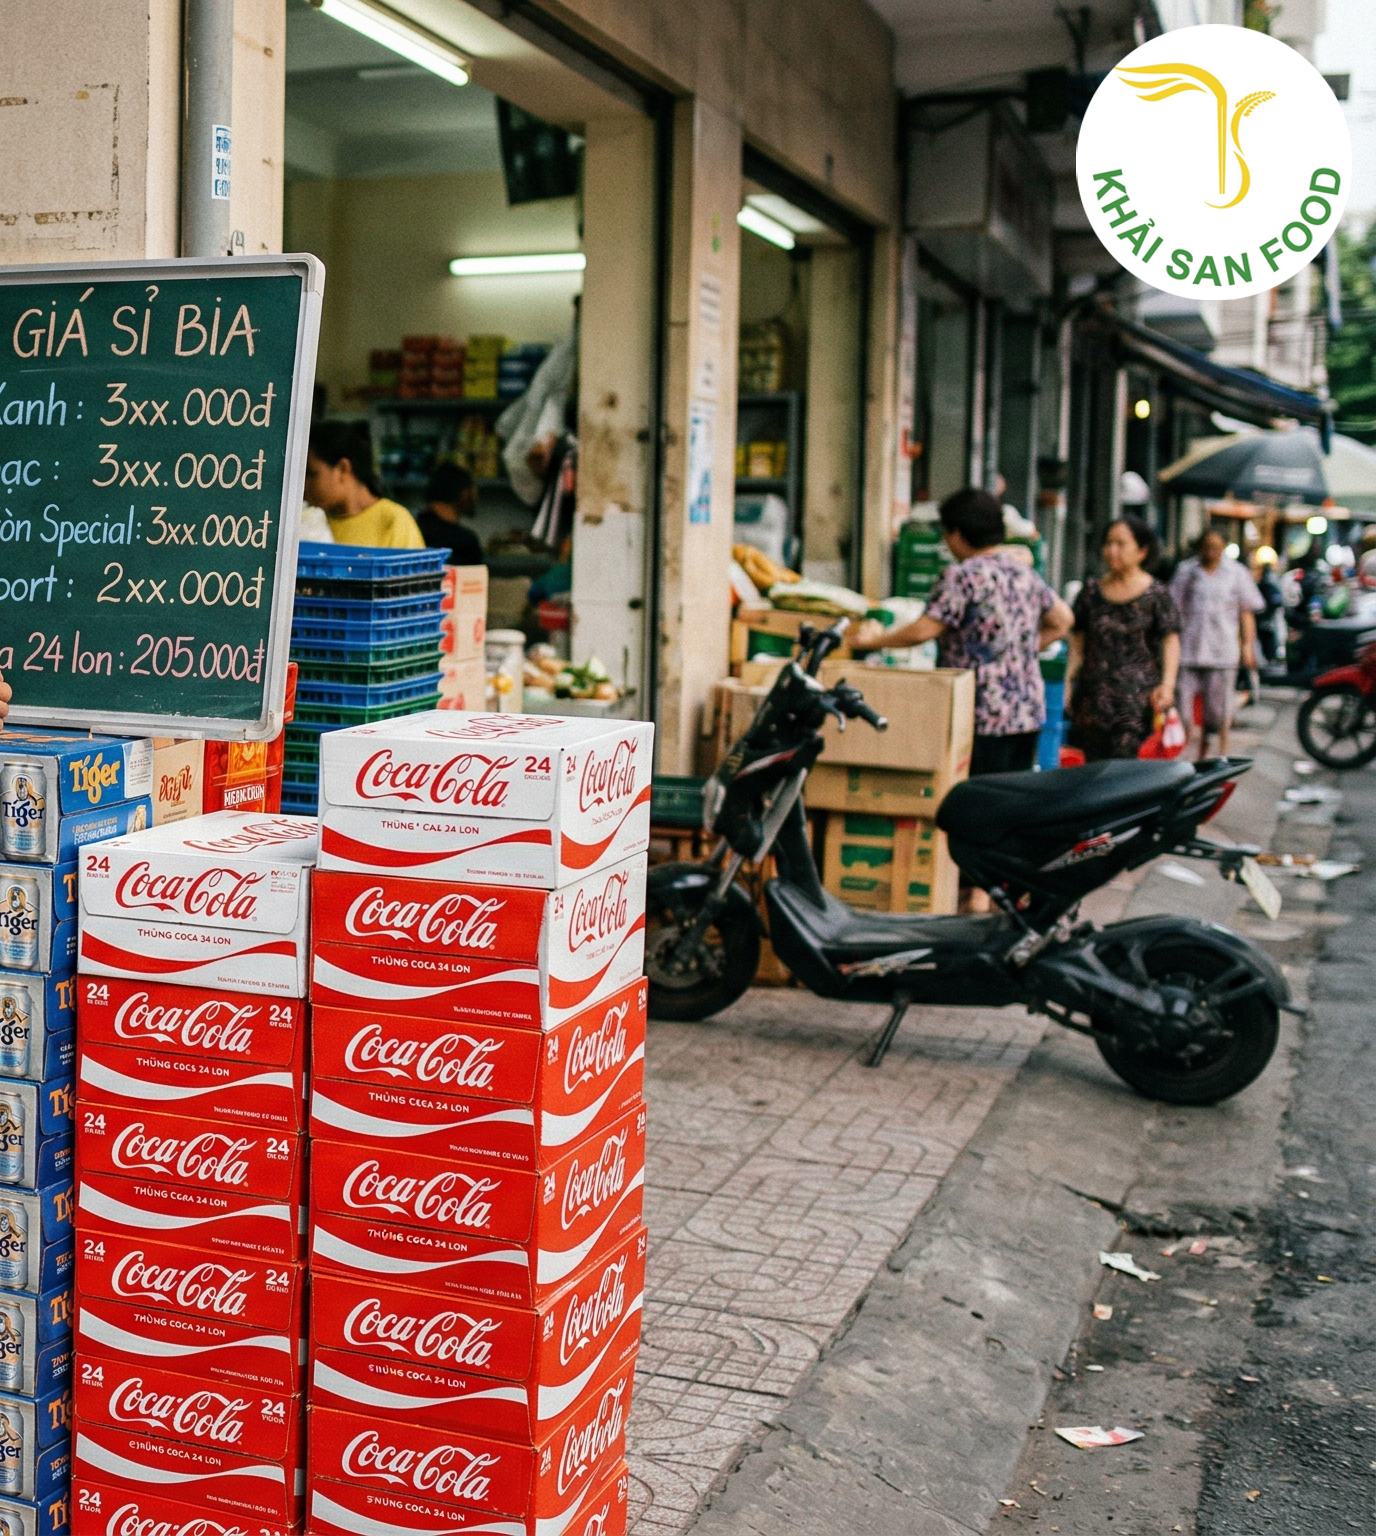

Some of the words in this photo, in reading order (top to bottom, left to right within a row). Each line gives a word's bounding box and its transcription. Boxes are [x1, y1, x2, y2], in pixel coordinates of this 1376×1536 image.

[99, 382, 276, 427] 3xx.000đ
[92, 444, 266, 490] 3xx.000đ
[97, 562, 265, 608] 2xx.000đ
[23, 631, 64, 673] 24
[130, 632, 265, 683] 205.000đ
[524, 756, 552, 774] 24
[580, 737, 639, 813] Coca-Cola
[69, 752, 121, 804] Tiger
[354, 749, 519, 807] Coca-Cola
[2, 799, 46, 828] Tiger
[460, 826, 479, 834] LON
[87, 855, 110, 873] 24
[115, 861, 267, 920] Coca-Cola
[345, 886, 508, 949] Coca-Cola
[569, 870, 629, 953] Coca-Cola
[175, 932, 198, 942] COCA
[213, 936, 231, 945] LON
[451, 963, 471, 973] LON
[86, 982, 110, 1000] 24
[114, 991, 263, 1052] Coca-Cola
[269, 1004, 293, 1023] 24
[344, 1024, 505, 1088] Coca-Cola
[564, 999, 630, 1095] Coca-Cola
[212, 1067, 230, 1077] LON
[436, 1102, 448, 1110] 24
[450, 1104, 470, 1113] LON
[83, 1112, 107, 1129] 24
[111, 1122, 257, 1186] Coca-Cola
[266, 1137, 290, 1155] 24
[561, 1125, 629, 1231] Coca-Cola
[196, 1196, 207, 1204] 24
[342, 1160, 502, 1228] Coca-Cola
[84, 1239, 106, 1256] 24
[435, 1240, 446, 1249] 24
[448, 1242, 467, 1252] LON
[111, 1250, 256, 1317] Coca-Cola
[266, 1269, 290, 1287] 24
[559, 1253, 628, 1367] Coca-Cola
[169, 1320, 193, 1331] COCA
[195, 1324, 206, 1333] 24
[208, 1328, 226, 1337] LON
[343, 1298, 503, 1367] Coca-Cola
[81, 1363, 104, 1381] 24
[406, 1370, 431, 1382] COCA
[447, 1378, 466, 1389] LON
[108, 1377, 253, 1443] Coca-Cola
[261, 1398, 286, 1417] 24
[167, 1448, 190, 1460] COCA
[192, 1453, 203, 1462] 24
[205, 1455, 222, 1467] LON
[341, 1430, 501, 1501] Coca-Cola
[79, 1488, 102, 1507] 24
[405, 1503, 431, 1515] COCA
